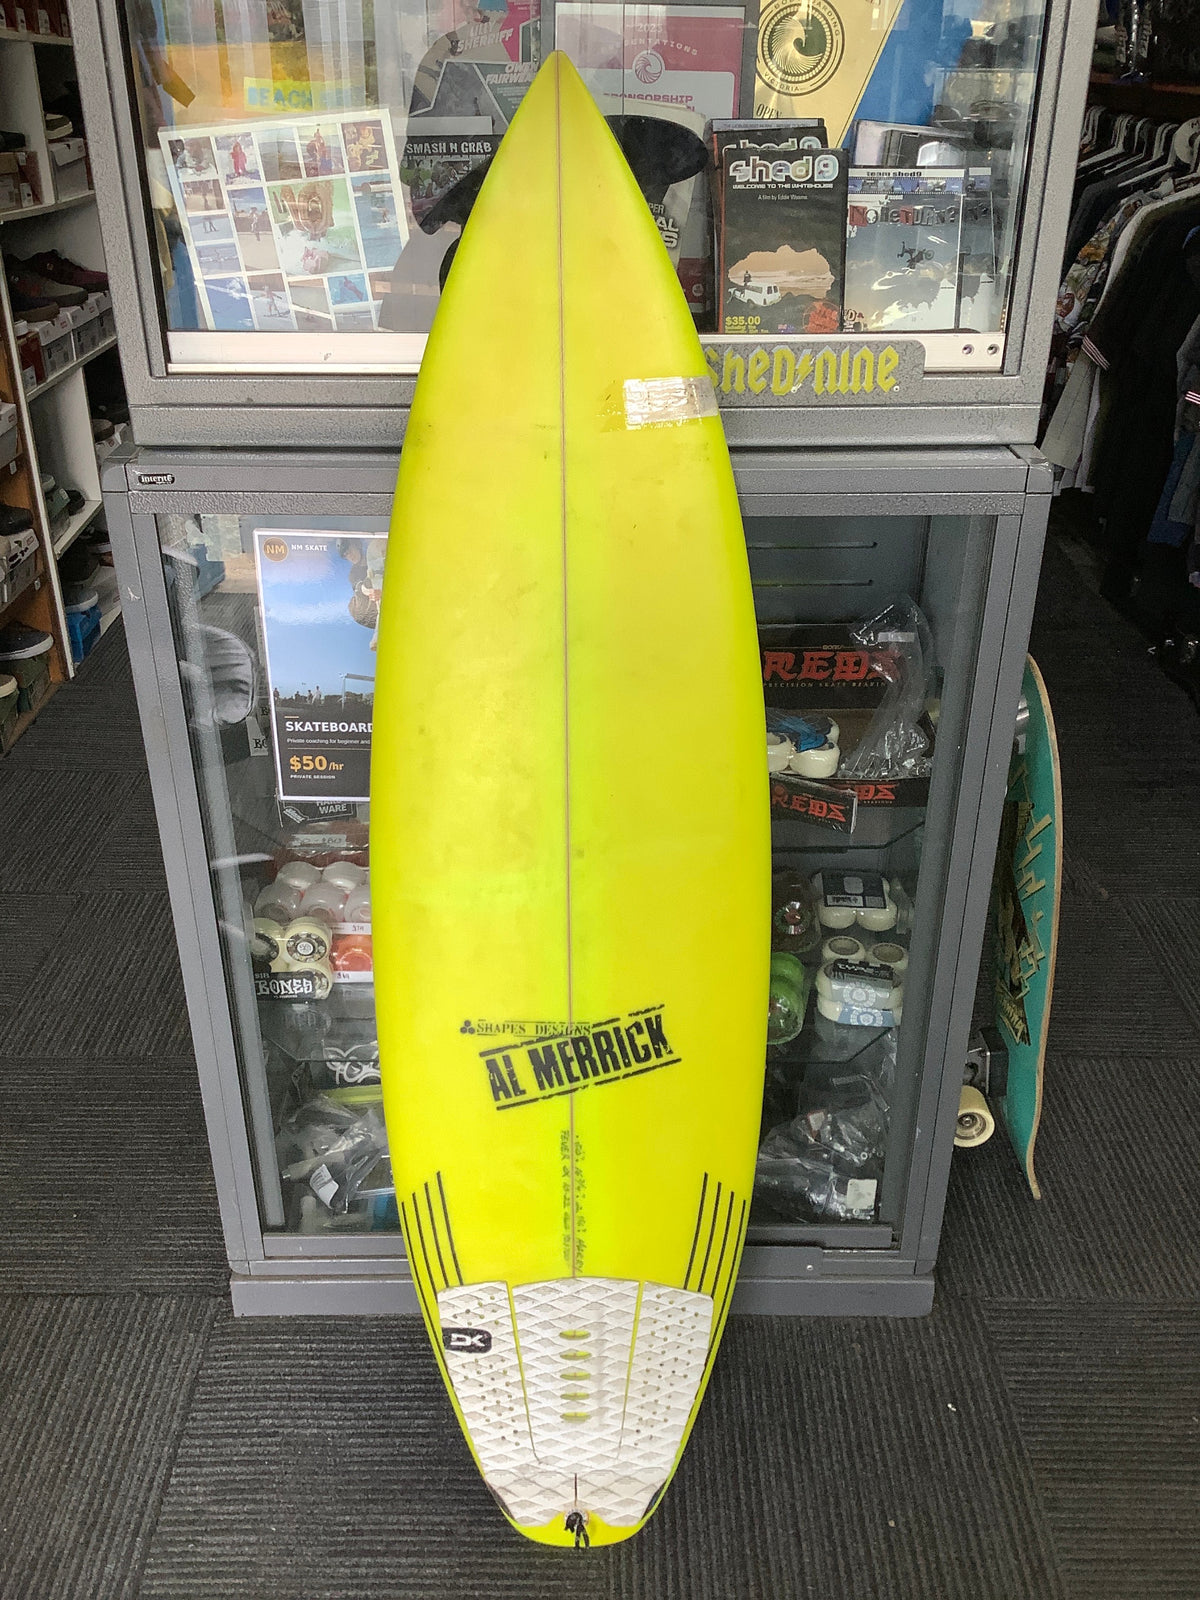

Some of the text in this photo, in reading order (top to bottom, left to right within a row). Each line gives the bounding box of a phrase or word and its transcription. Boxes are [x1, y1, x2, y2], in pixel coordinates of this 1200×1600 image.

[406, 141, 492, 154] SMASH N GRAB
[725, 316, 761, 327] $35.00
[266, 544, 285, 554] NM
[319, 803, 348, 814] WARE
[254, 978, 313, 996] BONES
[476, 1022, 591, 1036] SHAPES DESIGNS
[485, 1013, 675, 1102] AL MERRICK
